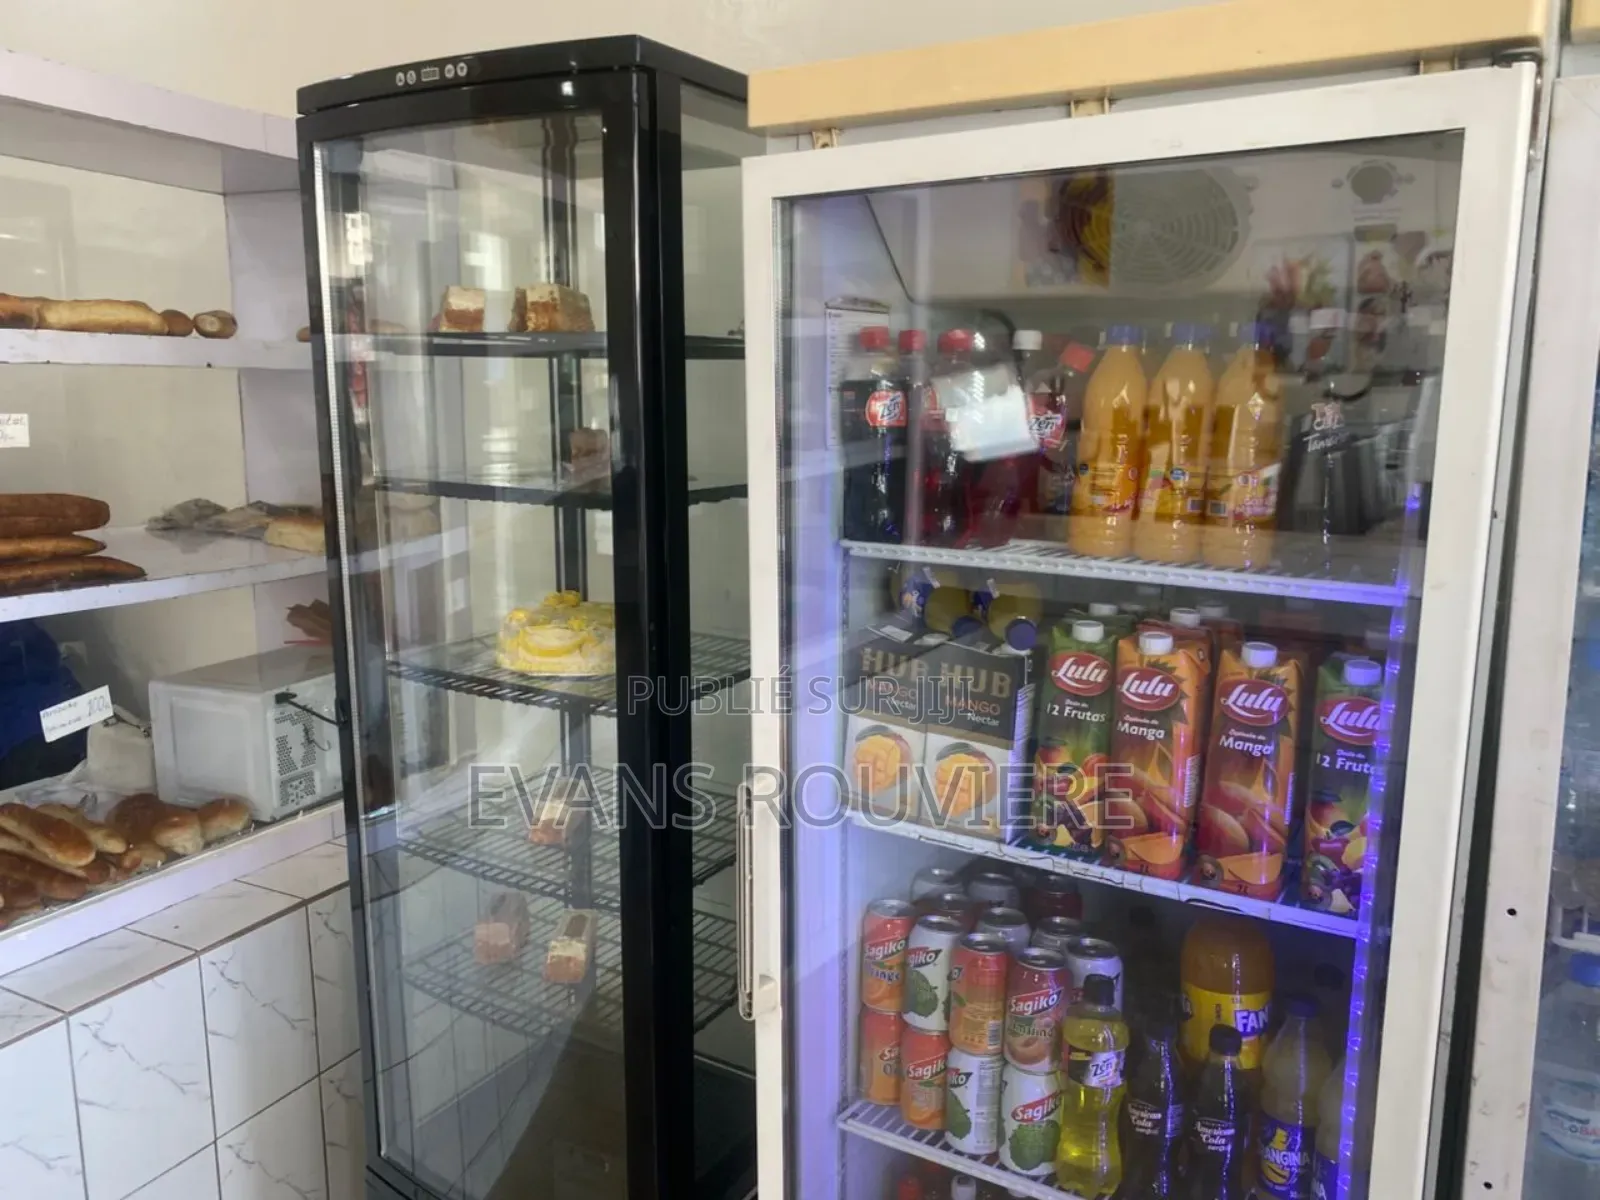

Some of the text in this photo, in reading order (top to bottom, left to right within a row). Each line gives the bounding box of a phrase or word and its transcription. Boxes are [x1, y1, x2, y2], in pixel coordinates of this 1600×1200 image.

[861, 647, 929, 682] HUB
[1051, 656, 1109, 689] Lulu
[940, 661, 1011, 698] HUB
[1118, 671, 1175, 704] Lulu
[945, 695, 1000, 716] MANGO
[1220, 683, 1284, 718] Lulu
[967, 713, 1000, 727] Nectar
[1046, 702, 1060, 716] 12
[1064, 706, 1107, 722] Frutas
[1319, 701, 1383, 737] Lulu
[1116, 720, 1166, 740] Manga
[1219, 735, 1274, 757] Manga
[865, 939, 906, 960] Sagiko
[908, 950, 936, 968] giko
[1010, 993, 1058, 1016] Sagiko
[1235, 1007, 1268, 1033] FAN
[908, 1059, 946, 1080] Sagik
[1091, 1059, 1113, 1077] Zen
[1200, 1133, 1226, 1145] Cola
